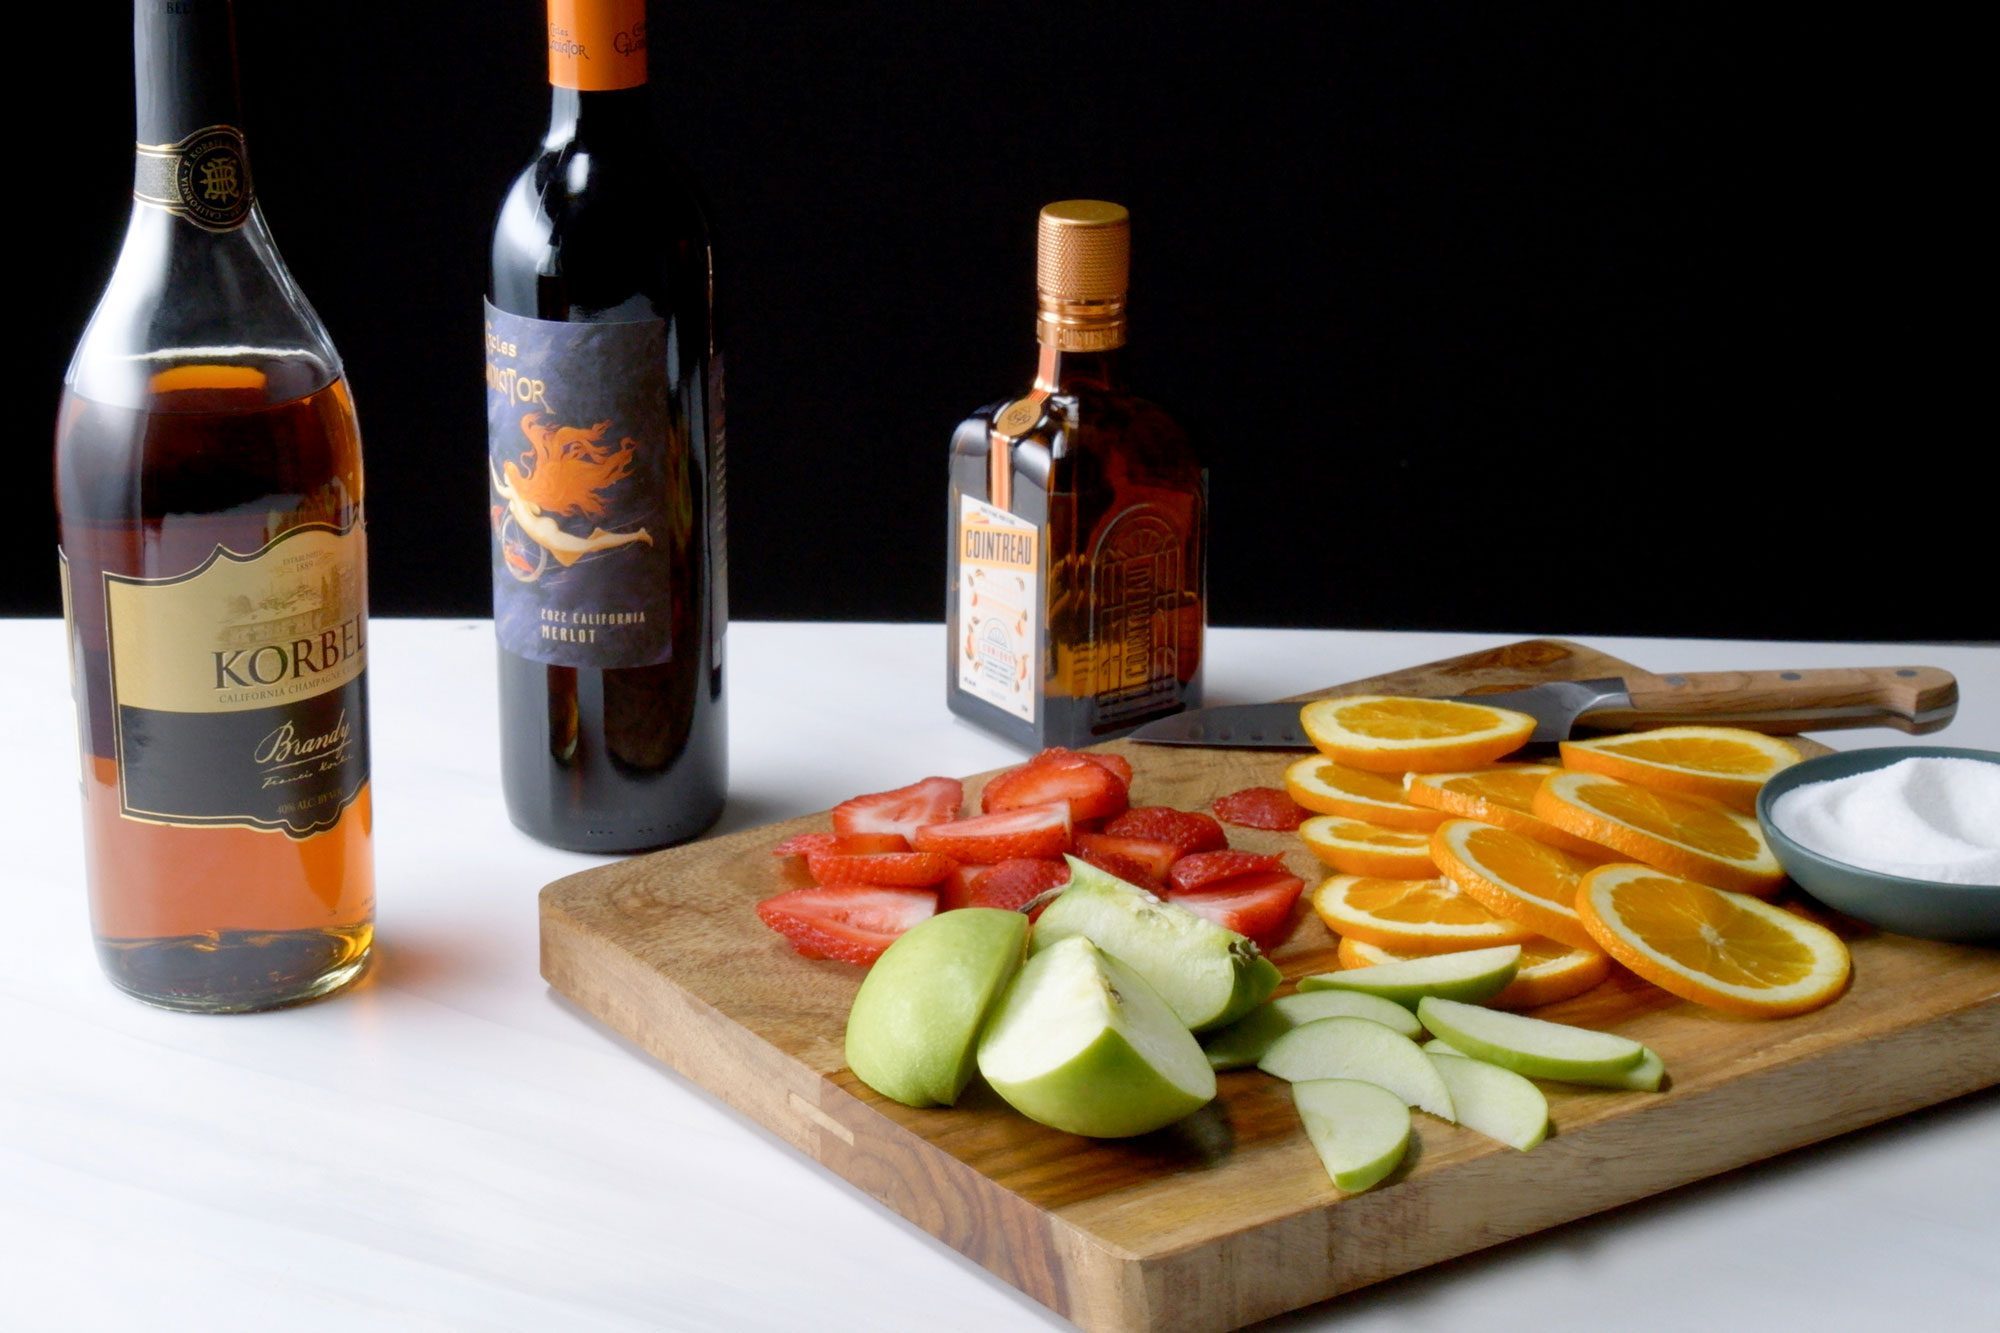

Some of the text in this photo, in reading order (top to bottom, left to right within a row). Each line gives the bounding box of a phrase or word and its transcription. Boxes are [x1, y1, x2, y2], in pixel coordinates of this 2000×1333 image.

[966, 529, 1033, 566] COINTREAU
[541, 624, 596, 644] MERLOT
[573, 612, 646, 626] CALIFORNIA
[212, 612, 367, 690] KORBEL
[219, 668, 342, 704] CALIFORNIA CHAMPAGNE
[254, 708, 351, 764] Brandy
